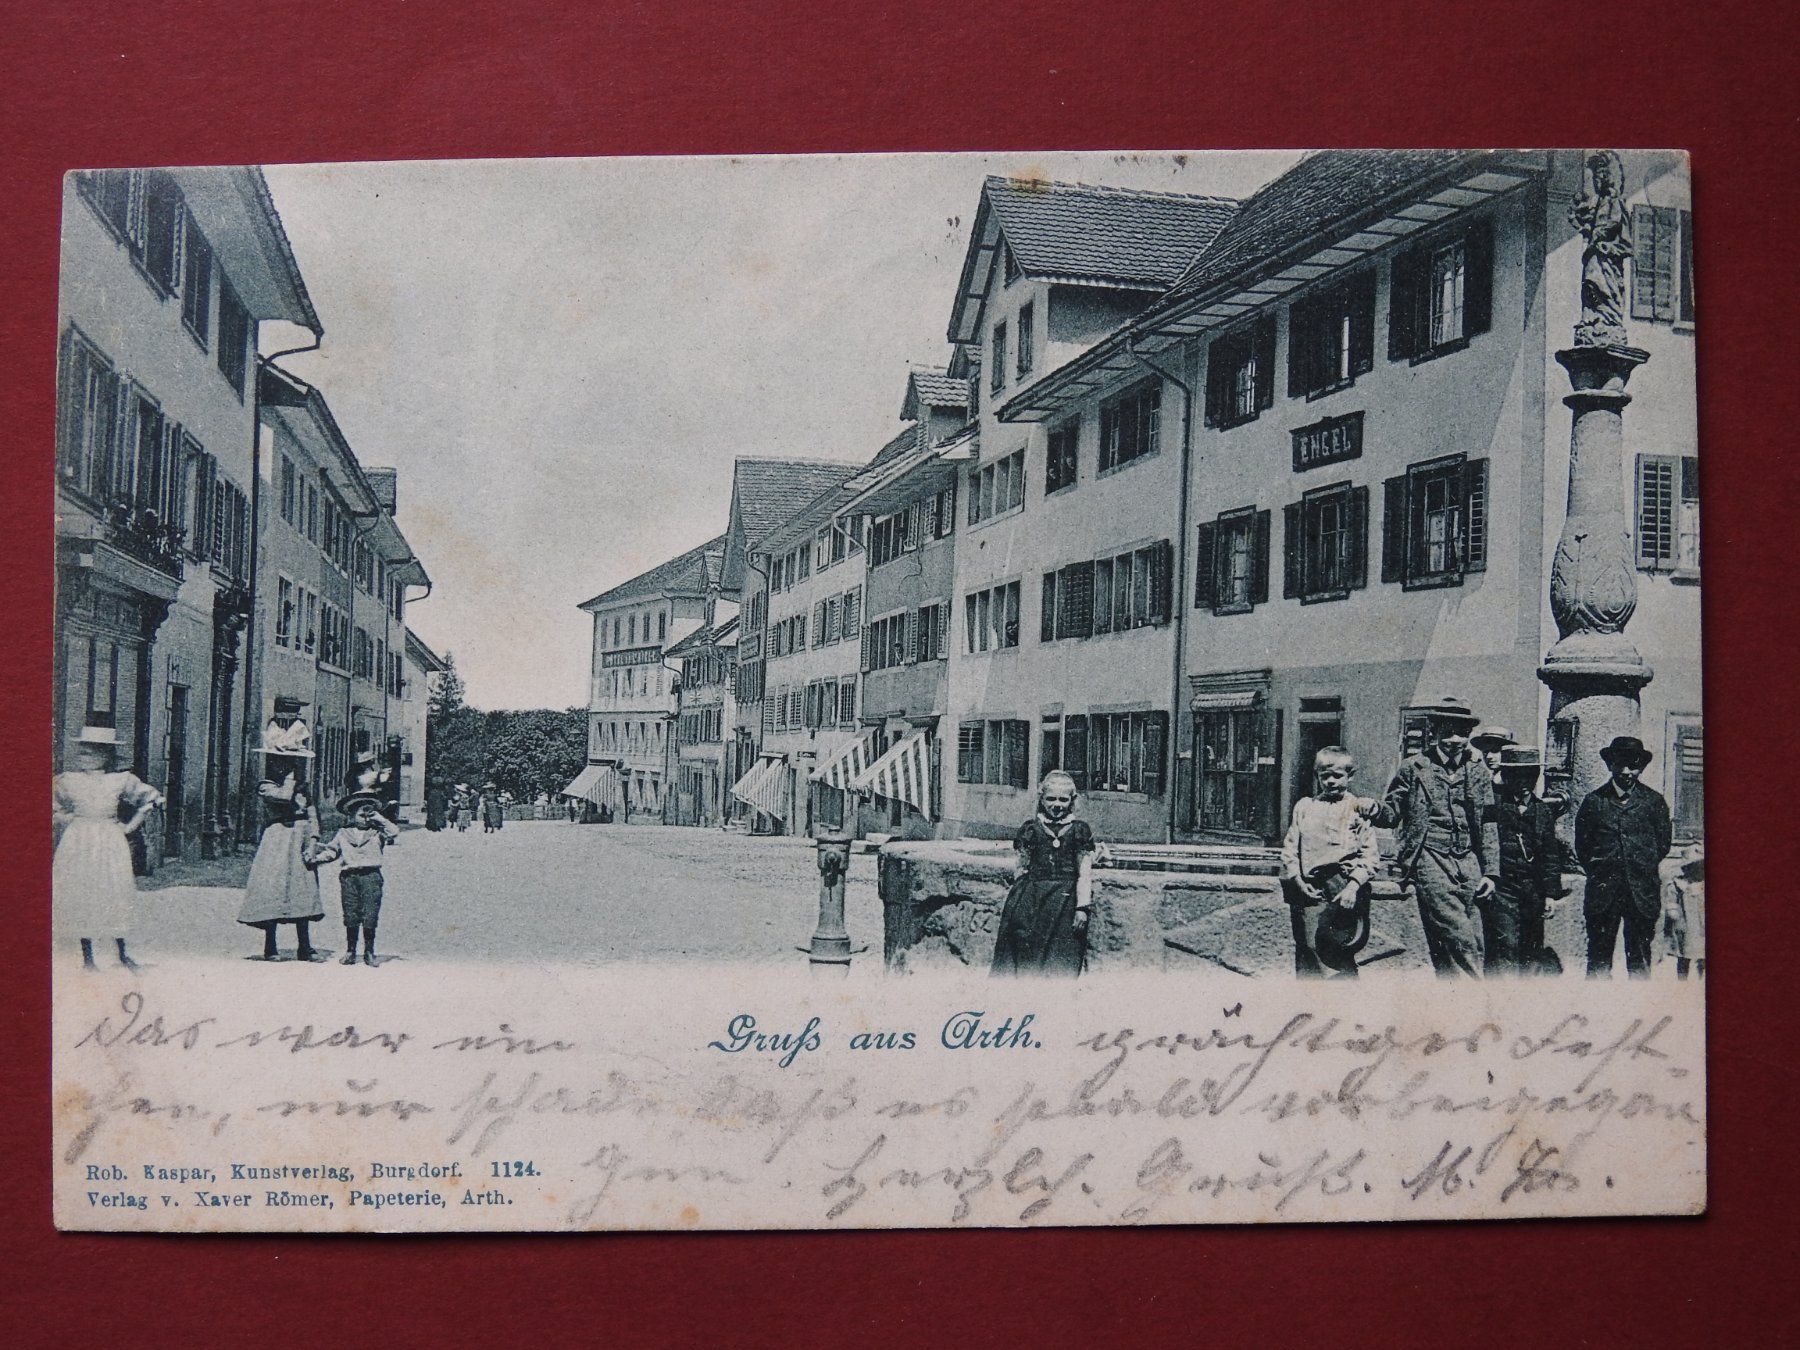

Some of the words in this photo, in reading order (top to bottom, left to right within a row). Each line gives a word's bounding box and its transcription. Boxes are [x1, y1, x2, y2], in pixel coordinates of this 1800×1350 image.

[849, 1031, 917, 1051] aus
[940, 1010, 1043, 1051] Arth.
[86, 1164, 129, 1181] Rob.
[143, 1164, 217, 1184] Kaspar,
[230, 1163, 355, 1183] Kunstverlag,
[370, 1161, 464, 1181] Burgdorf.
[490, 1160, 542, 1178] 1124.
[86, 1191, 149, 1211] Verlag
[160, 1195, 180, 1208] v.
[194, 1191, 253, 1208] Xaver
[265, 1190, 334, 1210] Römer,
[348, 1189, 447, 1210] Papeterie,
[460, 1188, 514, 1206] Arth.
